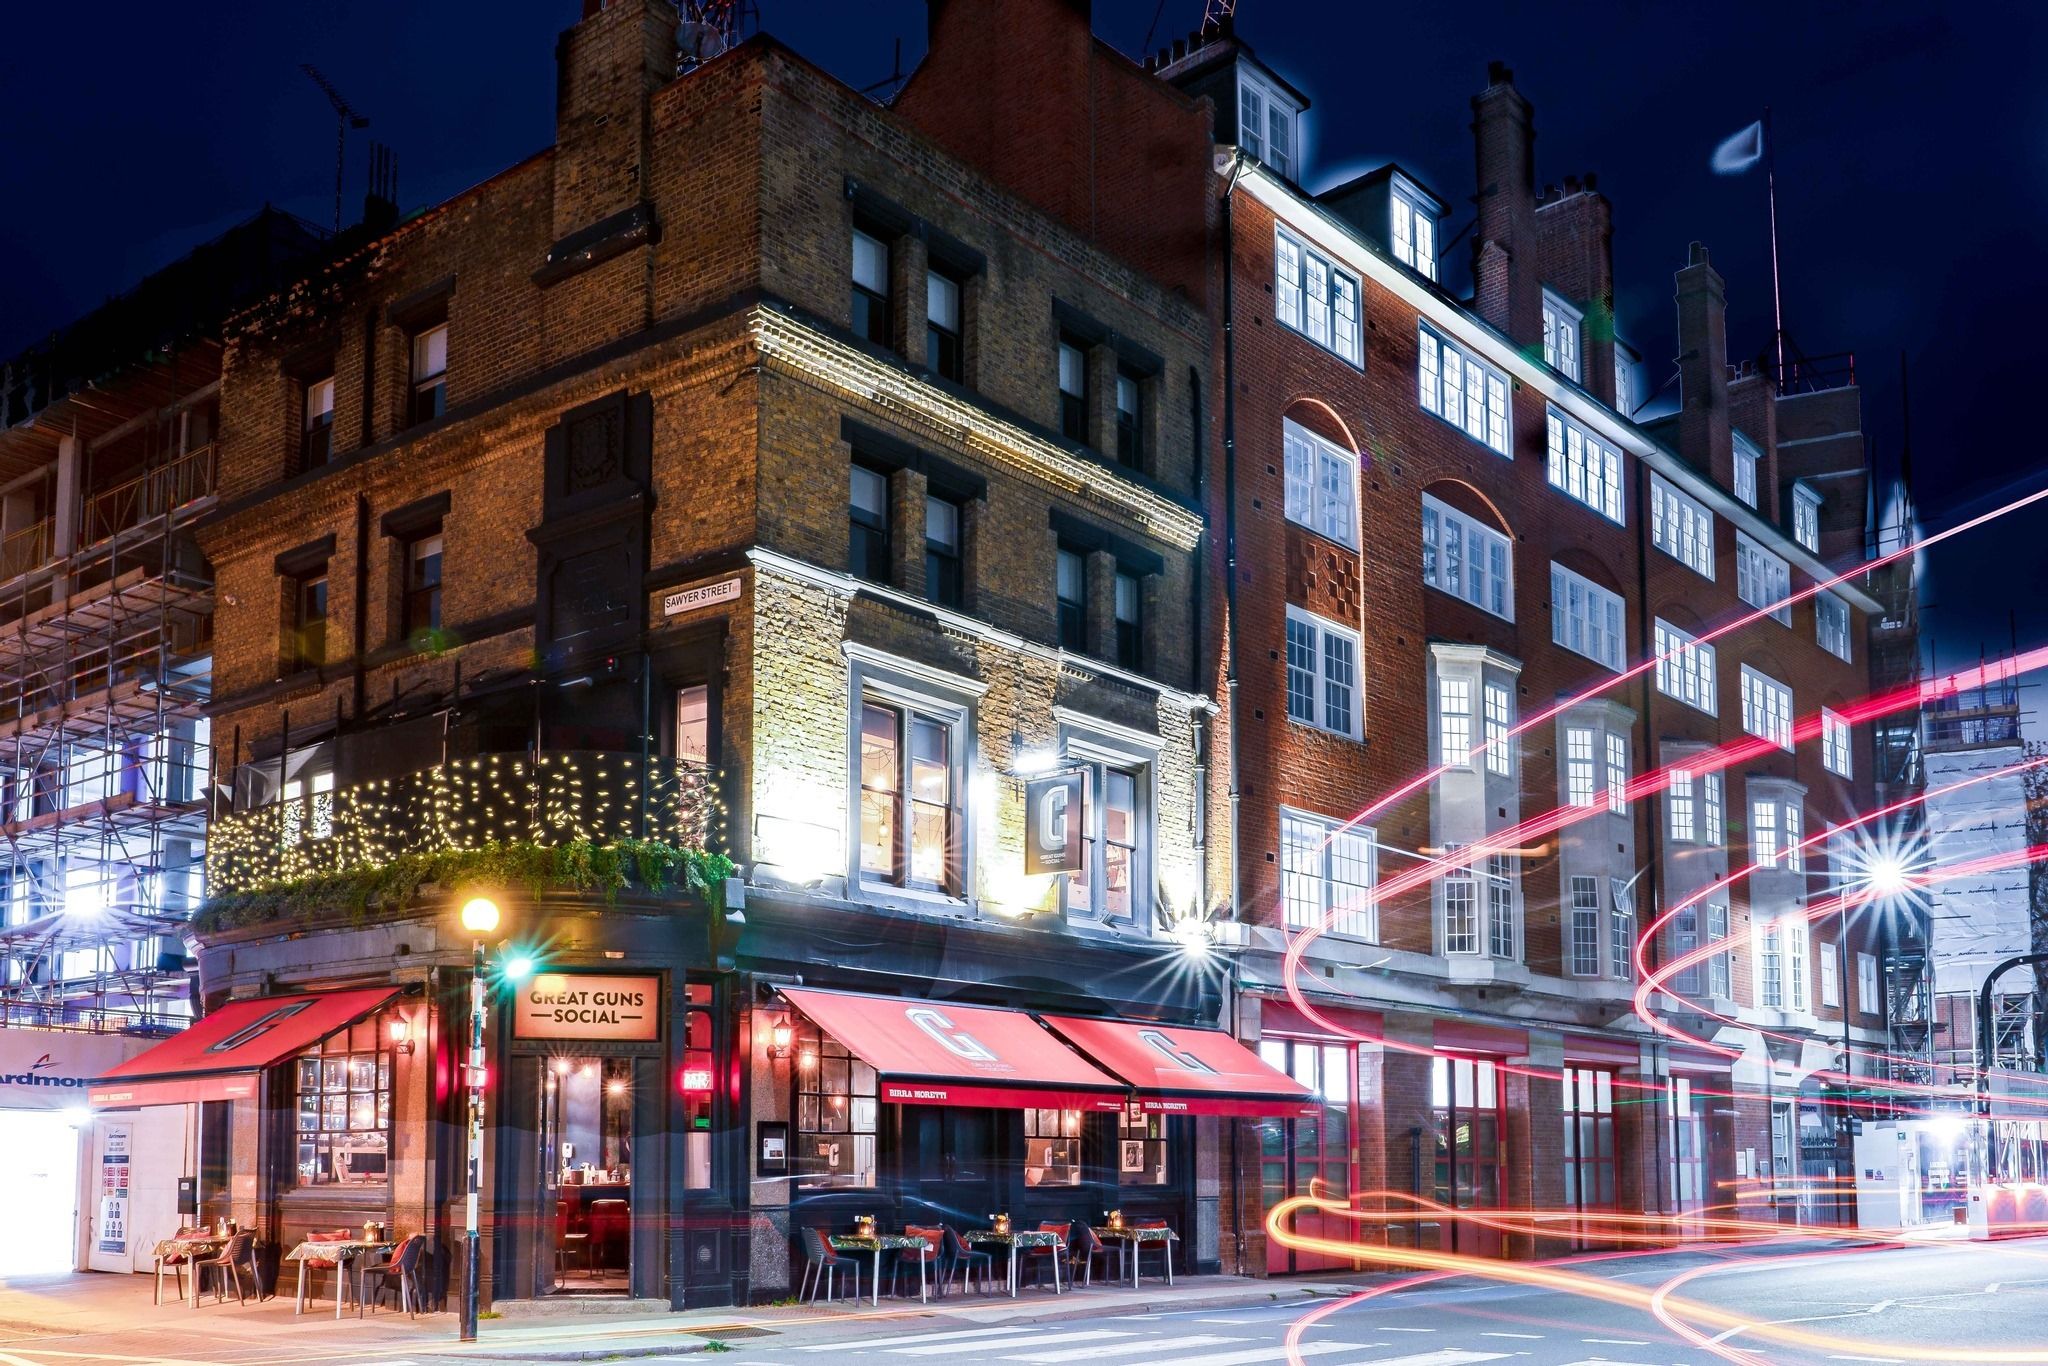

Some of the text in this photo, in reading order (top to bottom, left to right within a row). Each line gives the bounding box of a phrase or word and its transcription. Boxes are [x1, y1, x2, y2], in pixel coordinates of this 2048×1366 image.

[666, 591, 699, 608] SAWYER
[701, 582, 733, 599] STREET
[1040, 784, 1069, 851] G
[530, 991, 644, 1007] GREAT GUNS
[554, 1009, 620, 1024] SOCIAL
[0, 1072, 86, 1088] rdmor
[889, 1088, 947, 1099] BIRRA MORETTI
[1144, 1101, 1188, 1110] BIRRA MORETTI
